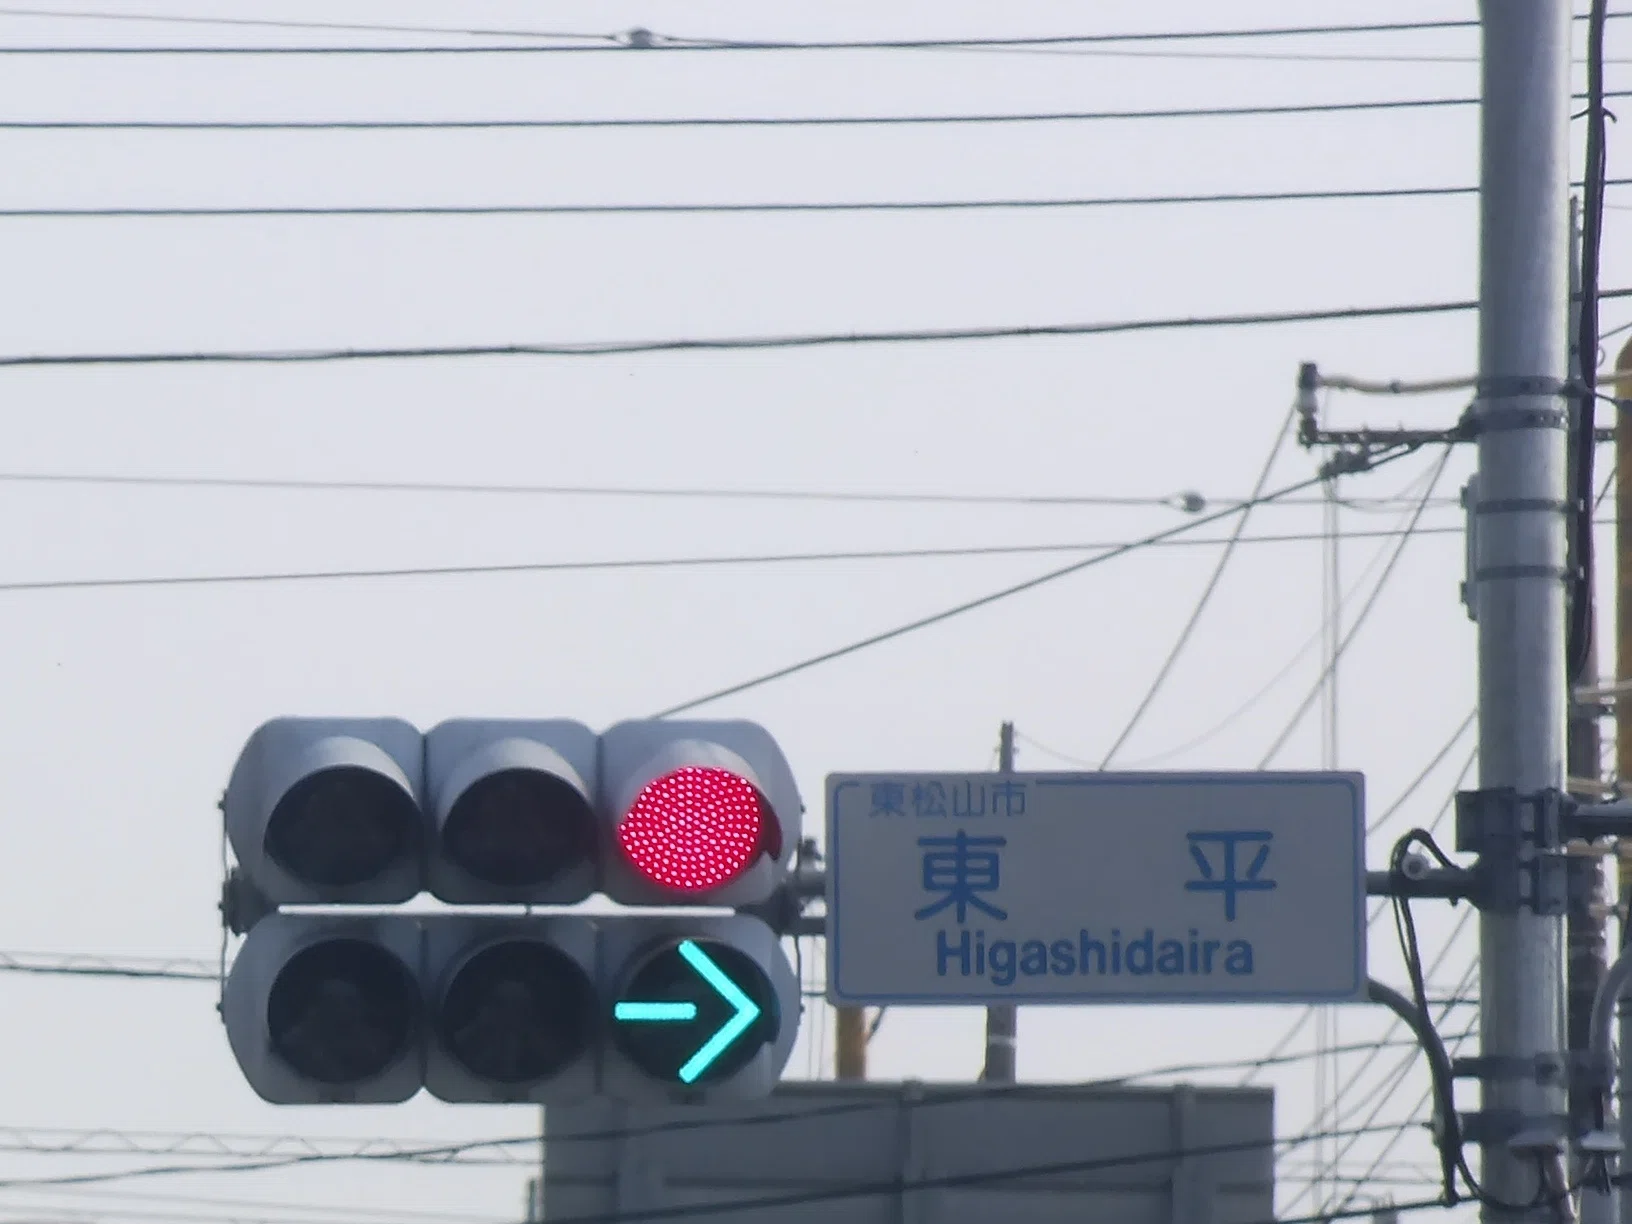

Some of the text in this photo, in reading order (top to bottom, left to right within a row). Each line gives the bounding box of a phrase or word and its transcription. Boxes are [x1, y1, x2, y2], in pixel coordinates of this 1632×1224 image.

[868, 779, 1028, 818] 東松山市
[914, 829, 1277, 924] 東平
[936, 930, 1254, 986] Higashidaira
